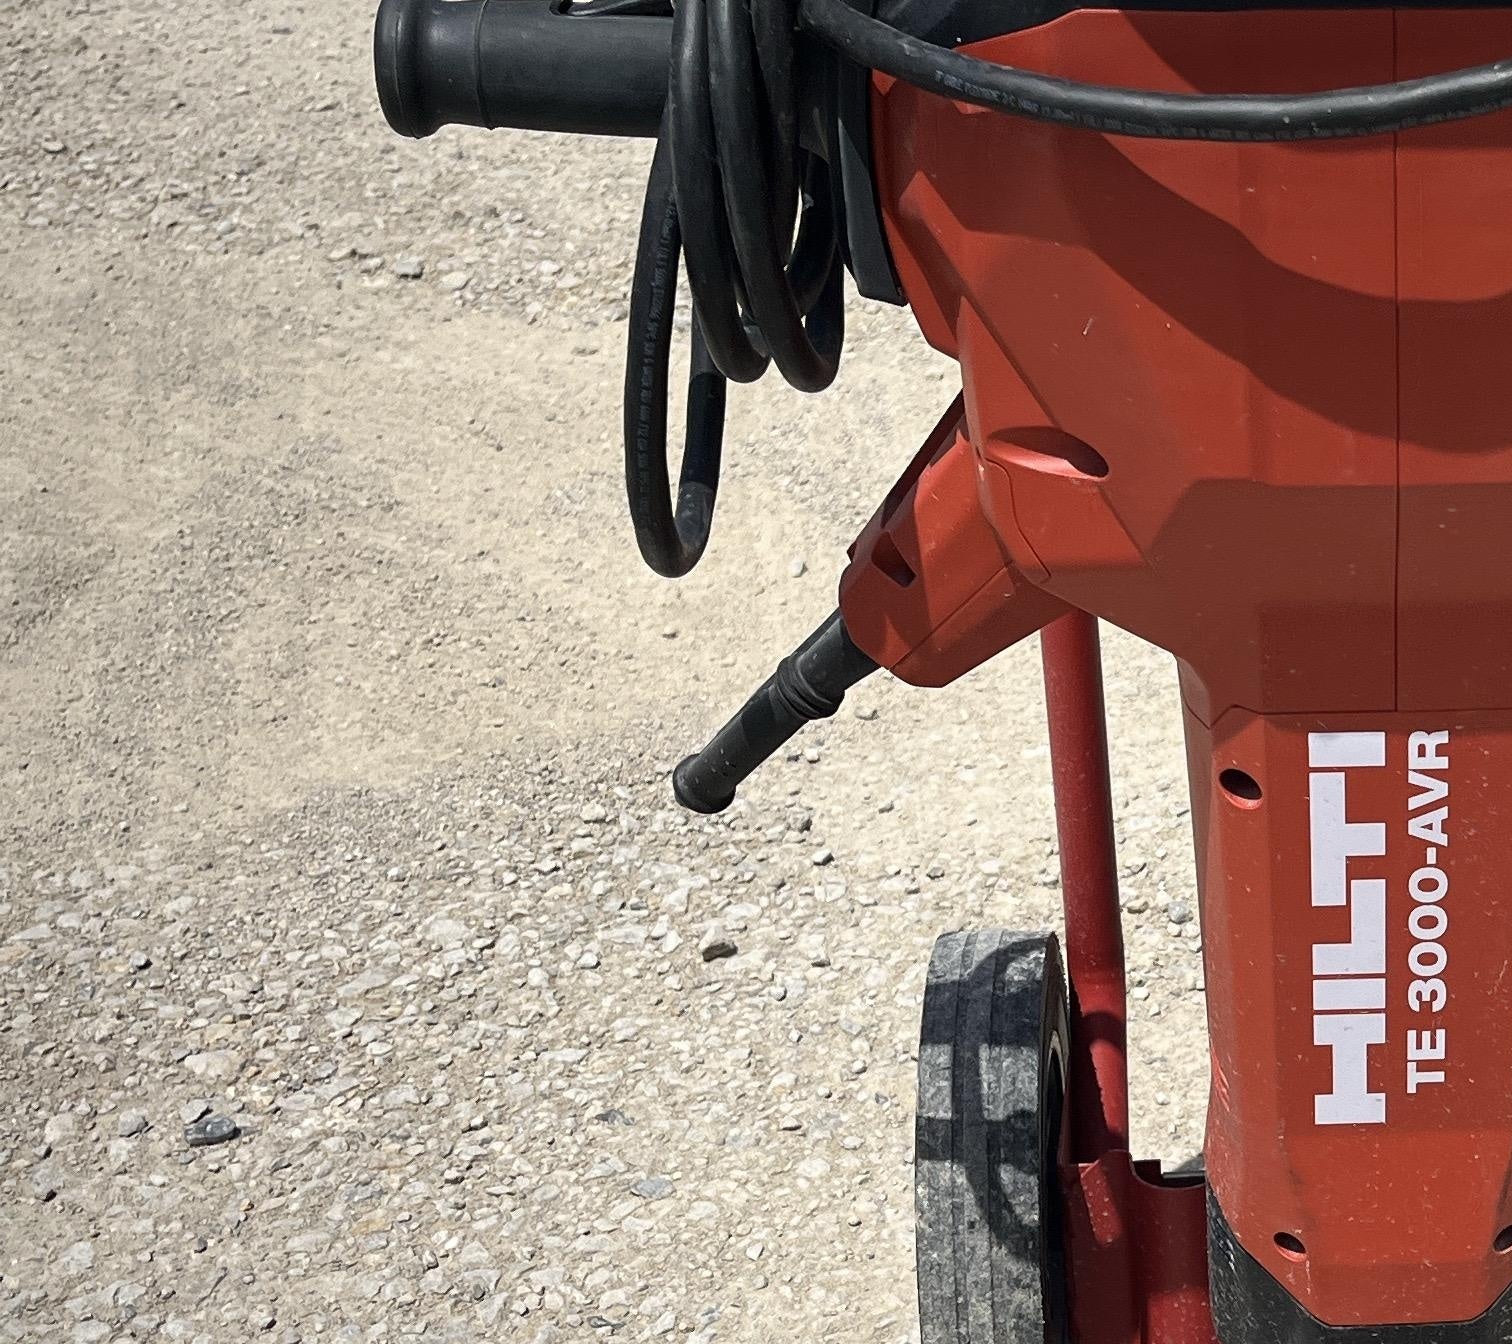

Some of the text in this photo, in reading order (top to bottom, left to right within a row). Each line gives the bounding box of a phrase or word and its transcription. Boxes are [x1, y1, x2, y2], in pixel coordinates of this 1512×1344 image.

[1307, 730, 1387, 1126] HILTI
[1406, 728, 1450, 1095] TE 3000-AVR
